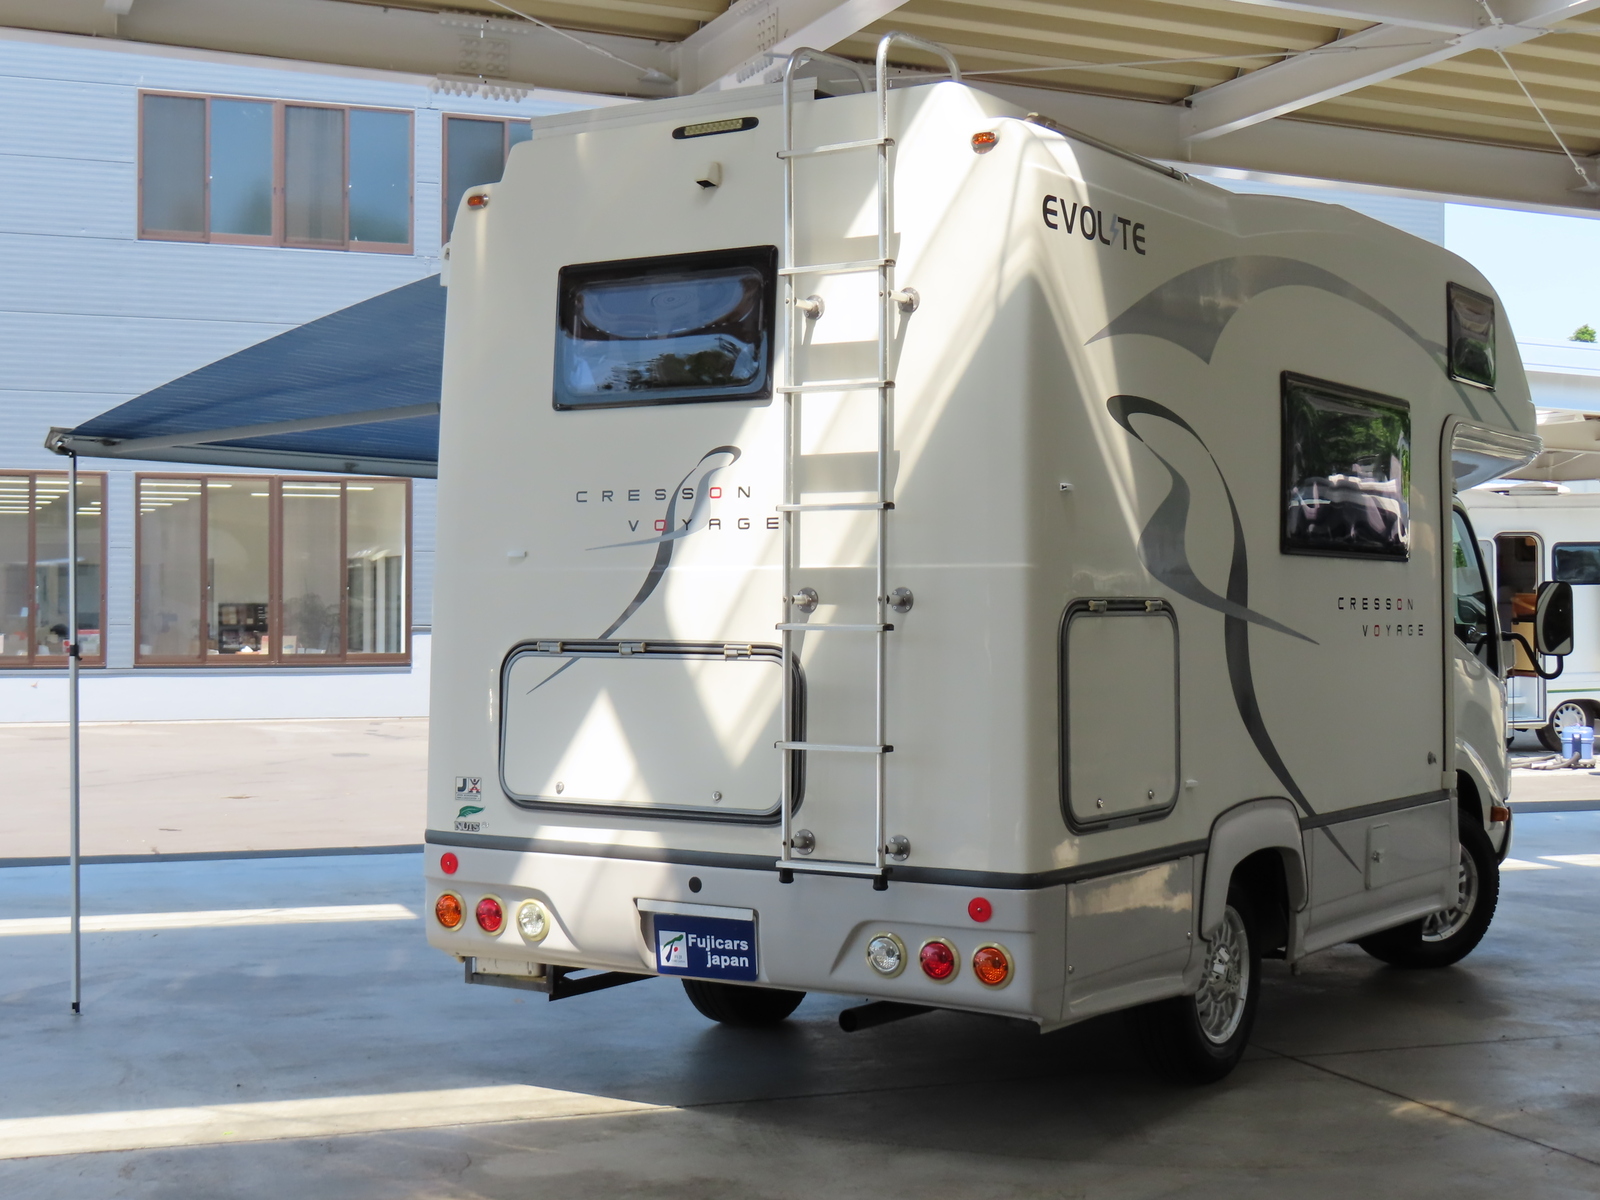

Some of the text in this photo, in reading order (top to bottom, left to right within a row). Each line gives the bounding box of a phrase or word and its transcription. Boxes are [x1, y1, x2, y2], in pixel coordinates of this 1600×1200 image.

[576, 486, 751, 502] CRESSON
[628, 517, 780, 532] VOYAGE
[1338, 597, 1414, 610] CRESSON
[1362, 624, 1424, 637] VOYAGE
[687, 933, 749, 951] Fujicars
[706, 951, 750, 968] japan
